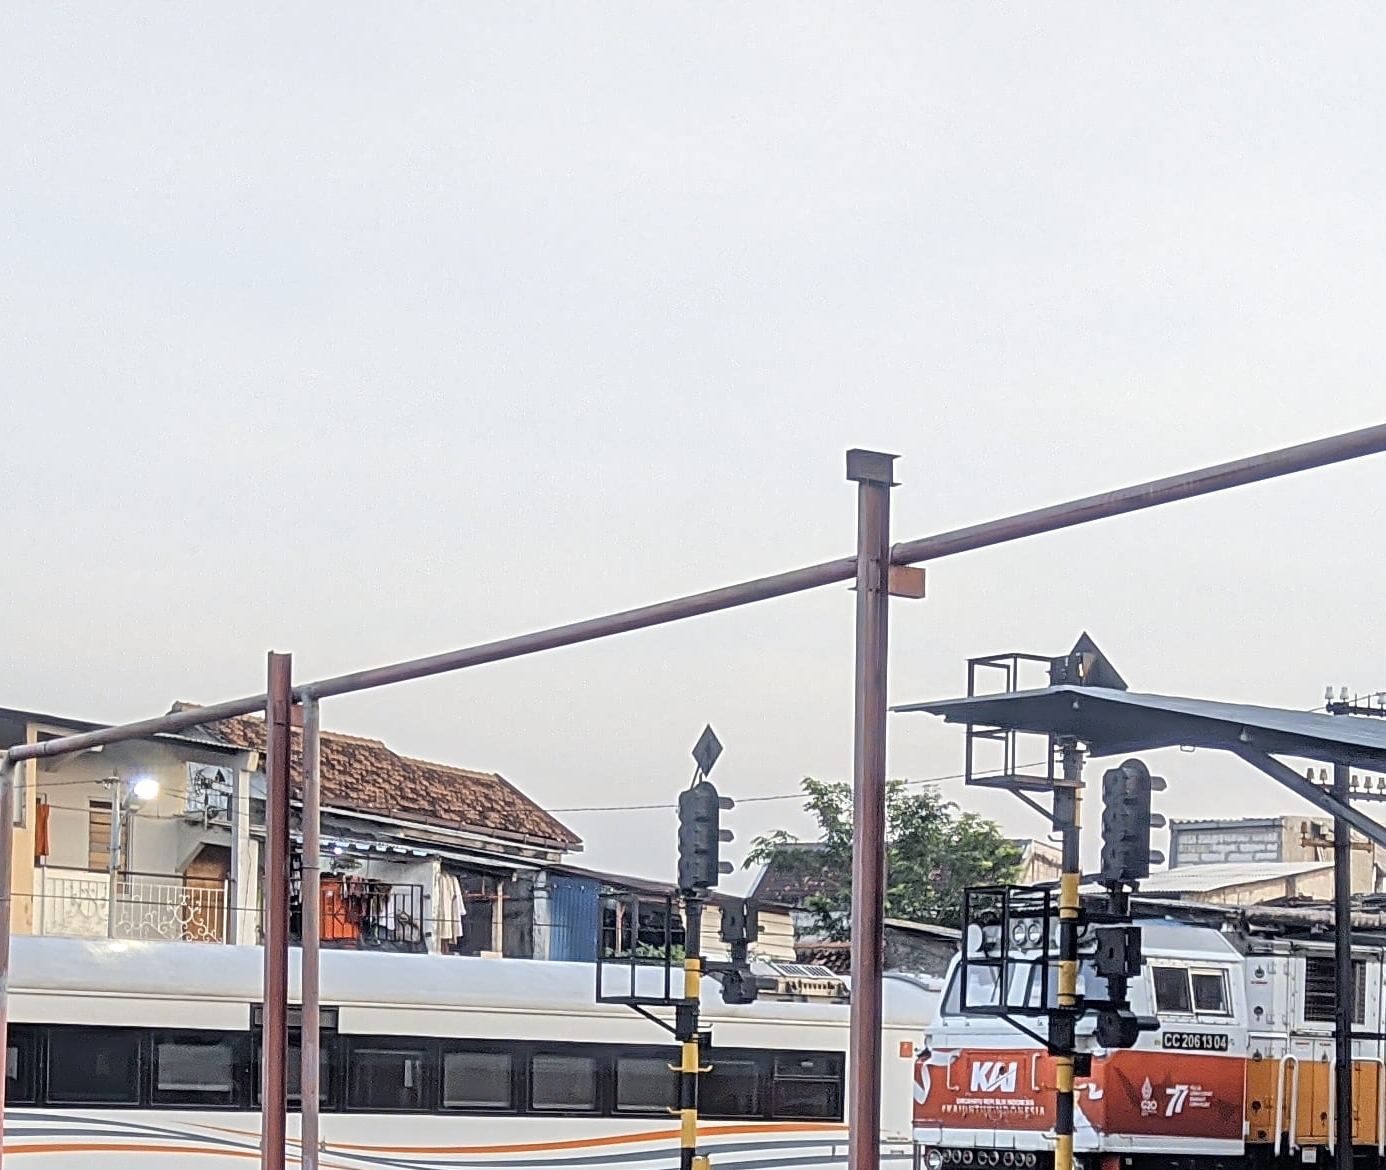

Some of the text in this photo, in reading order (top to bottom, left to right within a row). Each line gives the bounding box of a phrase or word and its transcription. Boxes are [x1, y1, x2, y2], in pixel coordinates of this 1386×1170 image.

[1164, 1033, 1227, 1049] CC 206 13 04
[970, 1061, 1018, 1093] KAI
